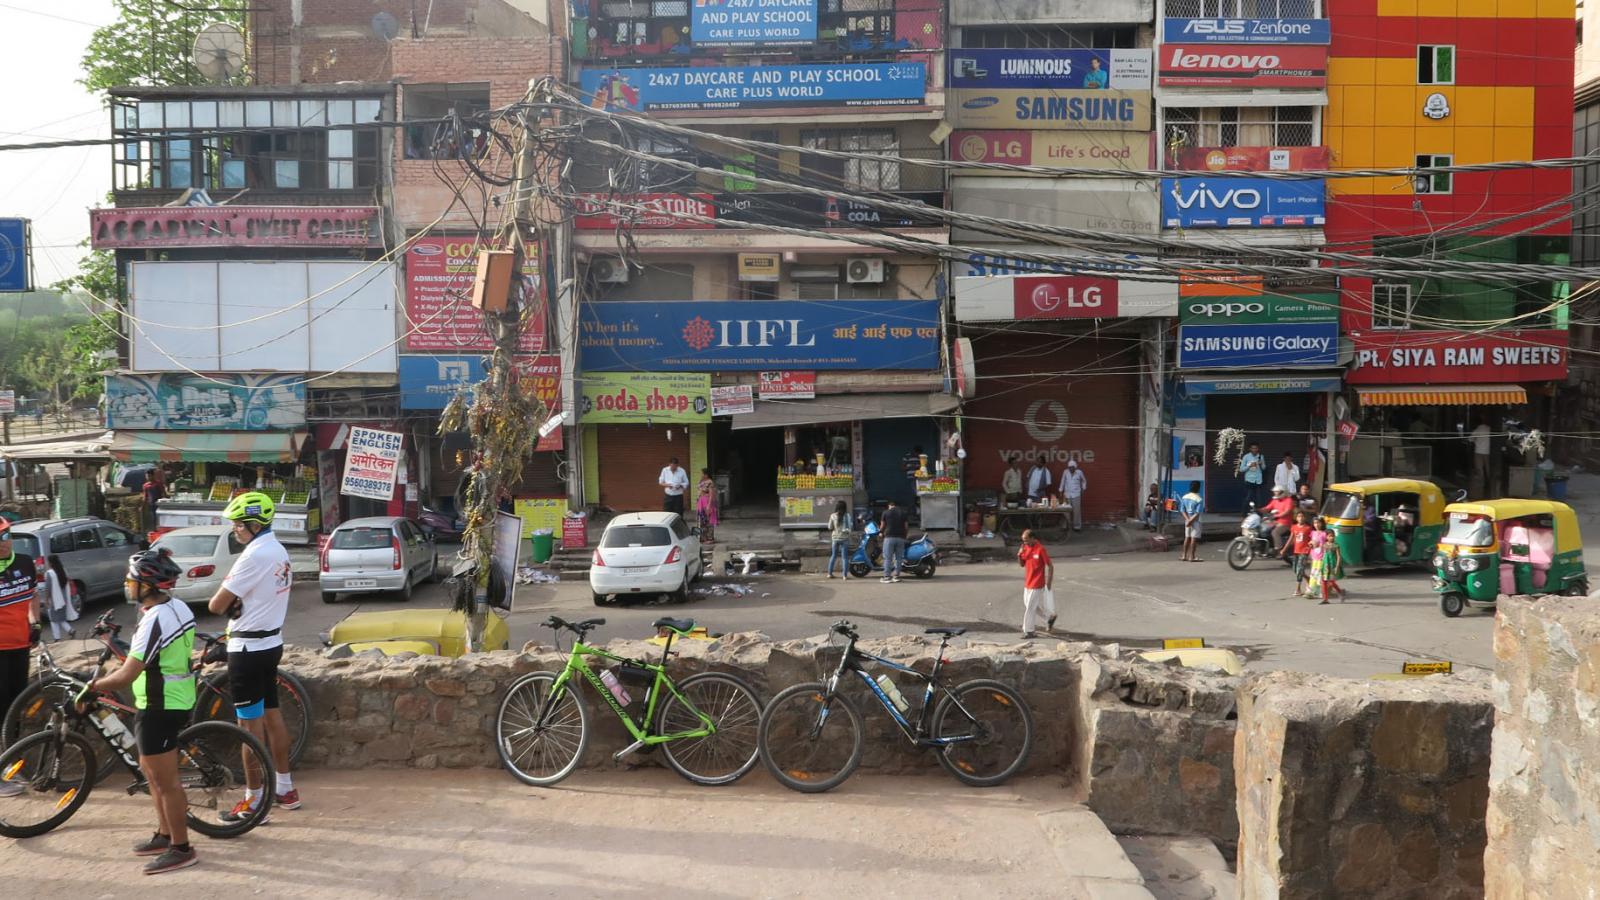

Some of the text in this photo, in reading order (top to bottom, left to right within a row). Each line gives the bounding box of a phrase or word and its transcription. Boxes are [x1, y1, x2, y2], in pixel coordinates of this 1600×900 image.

[702, 11, 812, 24] AND PLAY SCHOOL
[709, 28, 800, 38] CARE PLUS WORLD
[1183, 19, 1311, 34] ASUS Zenfone
[1000, 59, 1071, 75] LUMINOUS
[1171, 48, 1280, 69] lenovo
[648, 69, 882, 86] 24x7 DAYCARE AND PLAY SCHOOL
[706, 86, 824, 98] CARE PLUS WORLD
[1015, 96, 1134, 121] SAMSUNG
[993, 141, 1131, 158] LG Life's Good
[1171, 182, 1261, 208] vivo
[655, 198, 708, 215] STORE
[848, 212, 880, 222] COLA
[246, 218, 301, 239] SWEET
[1068, 286, 1102, 308] LG
[1189, 303, 1264, 316] oppo
[1275, 304, 1304, 312] Camera
[582, 320, 618, 333] When
[715, 319, 816, 347] IIFL
[832, 323, 938, 340] आई आई एफ एल
[581, 336, 614, 347] about
[1184, 335, 1330, 352] SAMSUNG Galaxy
[1360, 346, 1560, 367] Pt. SIYA RAM SWEETS
[595, 388, 639, 412] soda
[646, 387, 689, 414] shop
[352, 437, 400, 451] ENGLISH
[353, 430, 401, 443] SPOKEN
[998, 446, 1095, 463] vodafone
